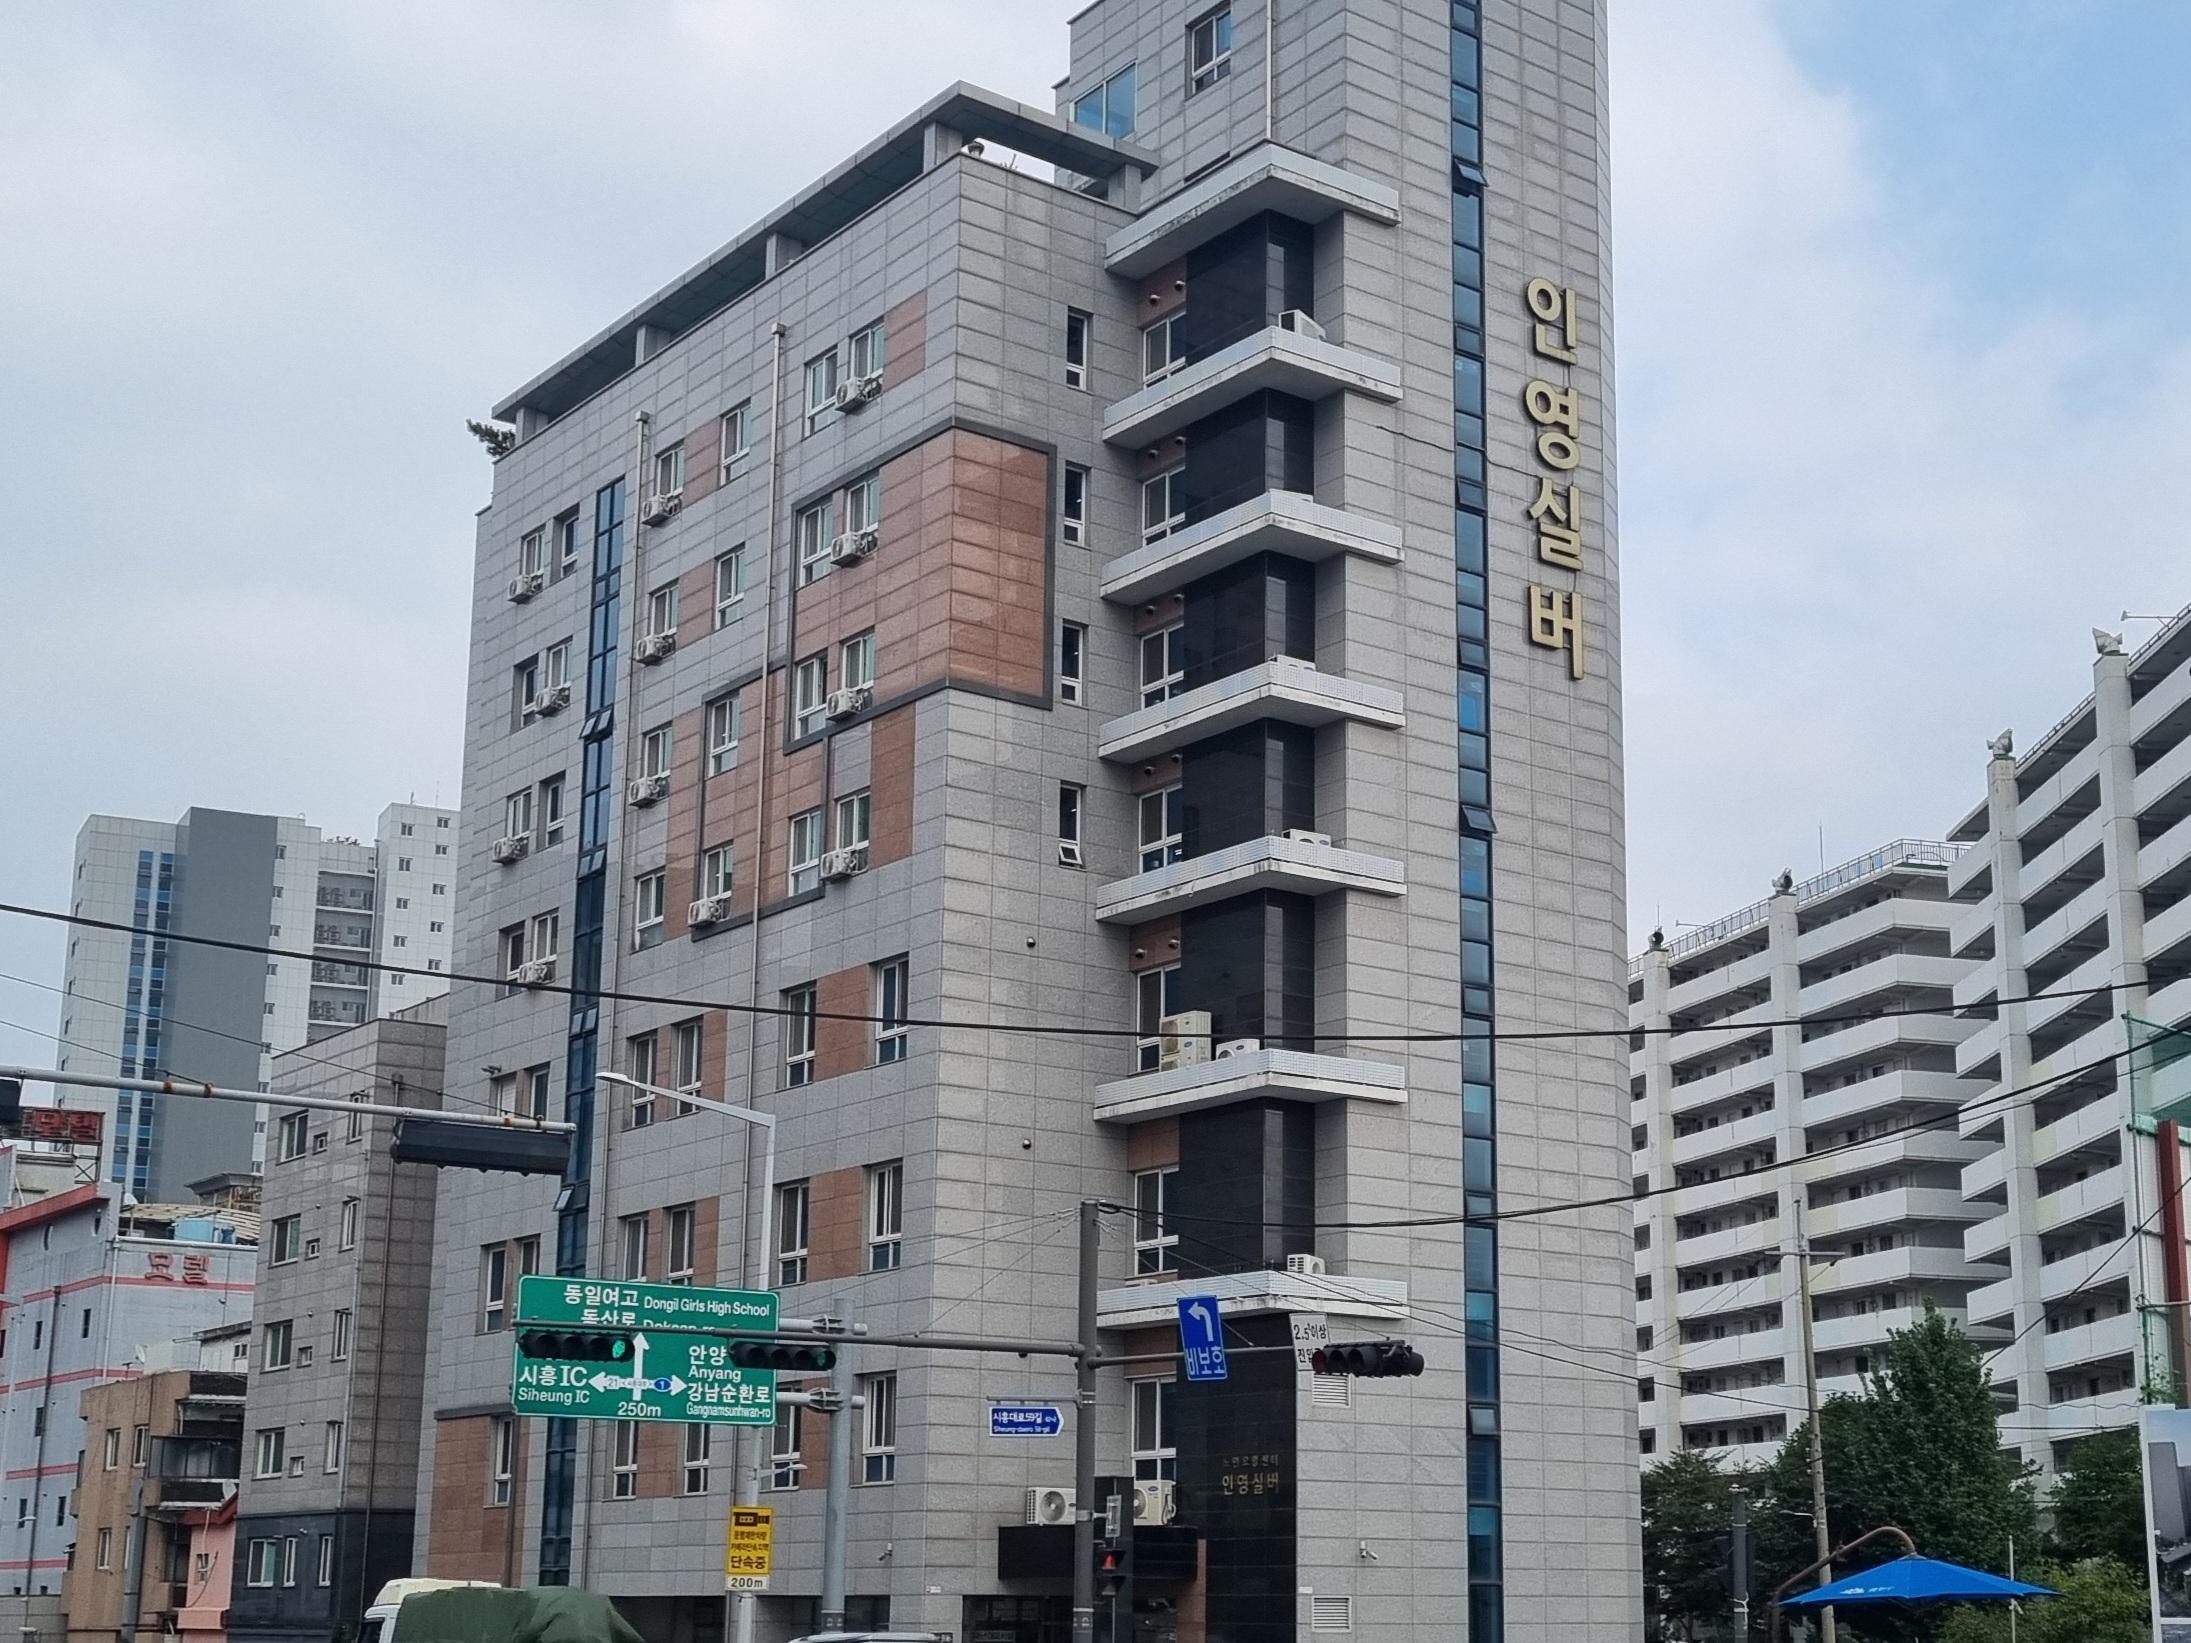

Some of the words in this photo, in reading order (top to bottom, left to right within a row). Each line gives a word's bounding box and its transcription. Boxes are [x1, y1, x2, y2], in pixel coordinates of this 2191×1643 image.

[1525, 276, 1584, 680] 인영실버
[564, 1284, 639, 1307] 동일여고
[644, 1296, 679, 1313] Dongil
[681, 1298, 705, 1312] Girls
[707, 1300, 731, 1316] High
[732, 1304, 769, 1316] School
[689, 1345, 728, 1366] 안양
[1184, 1345, 1225, 1375] 비보호
[688, 1365, 741, 1382] Anyang
[518, 1387, 572, 1405] Siheung
[575, 1389, 590, 1403] IC
[687, 1382, 771, 1404] 강남순환로
[617, 1401, 661, 1417] 250m
[730, 1555, 767, 1570] 단속중
[730, 1577, 763, 1588] 200m
